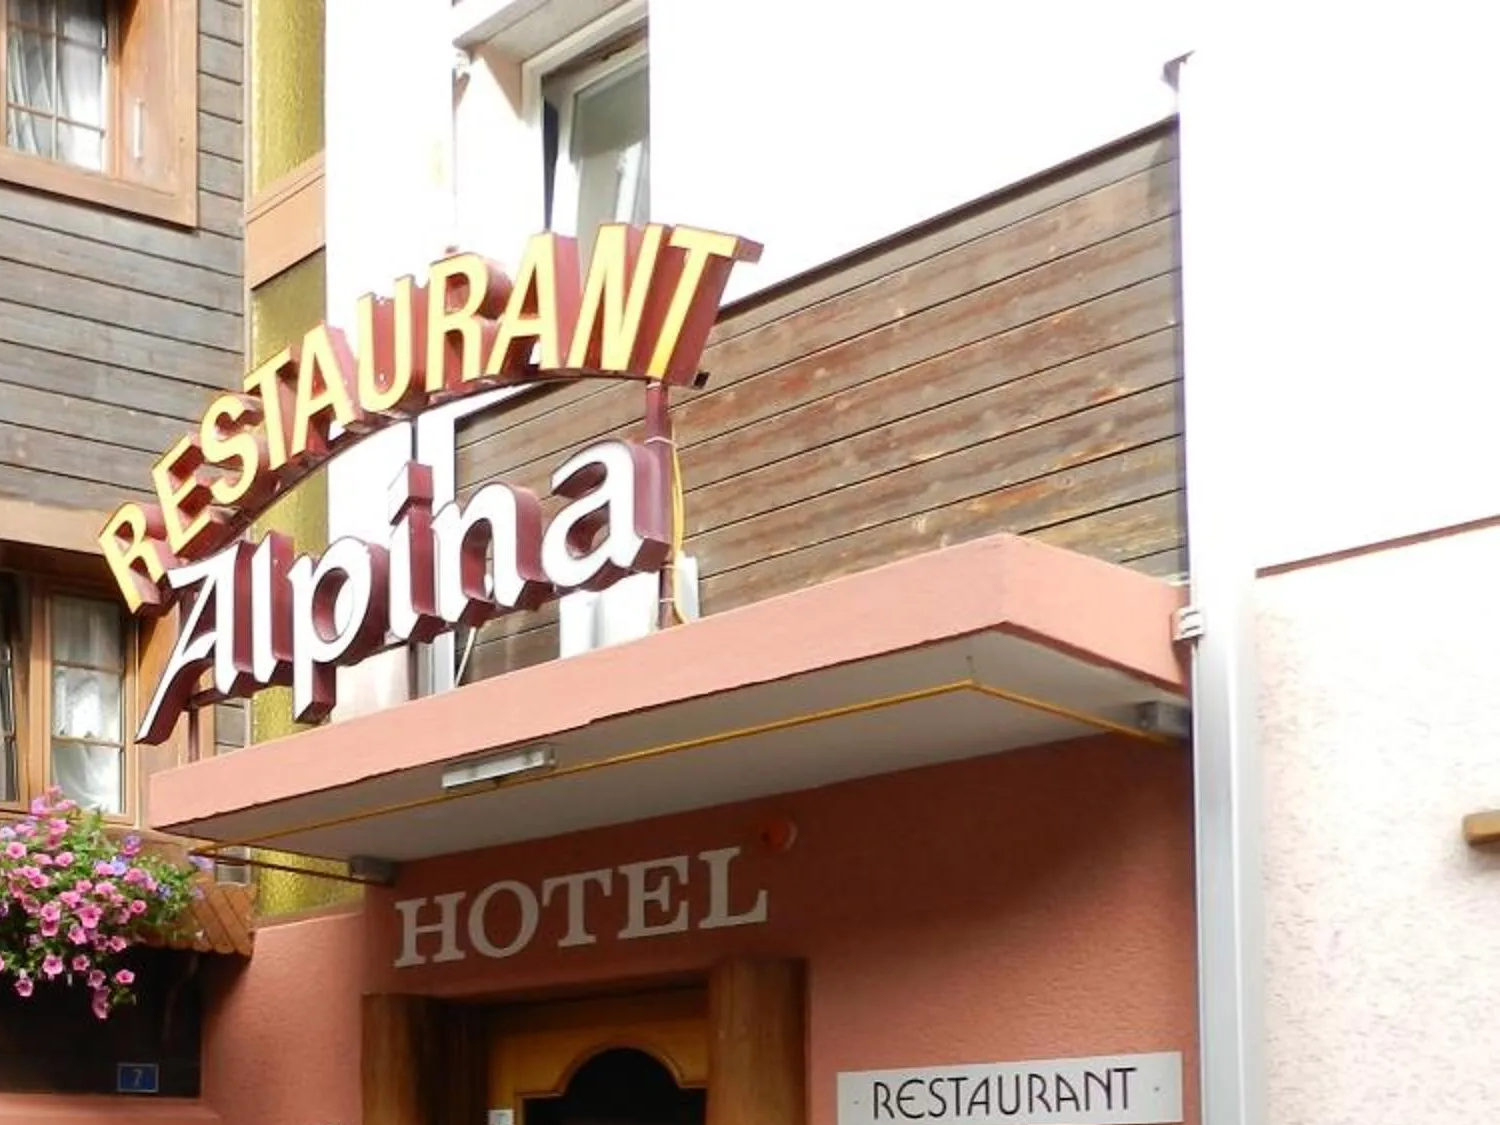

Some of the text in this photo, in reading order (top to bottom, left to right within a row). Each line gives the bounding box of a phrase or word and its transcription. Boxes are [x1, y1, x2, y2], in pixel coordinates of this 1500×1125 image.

[97, 222, 763, 617] RESTAURANT
[135, 438, 671, 746] Alpina
[394, 846, 768, 968] HOTEL
[132, 1069, 143, 1088] 7
[873, 1067, 1138, 1120] RESTAURANT
